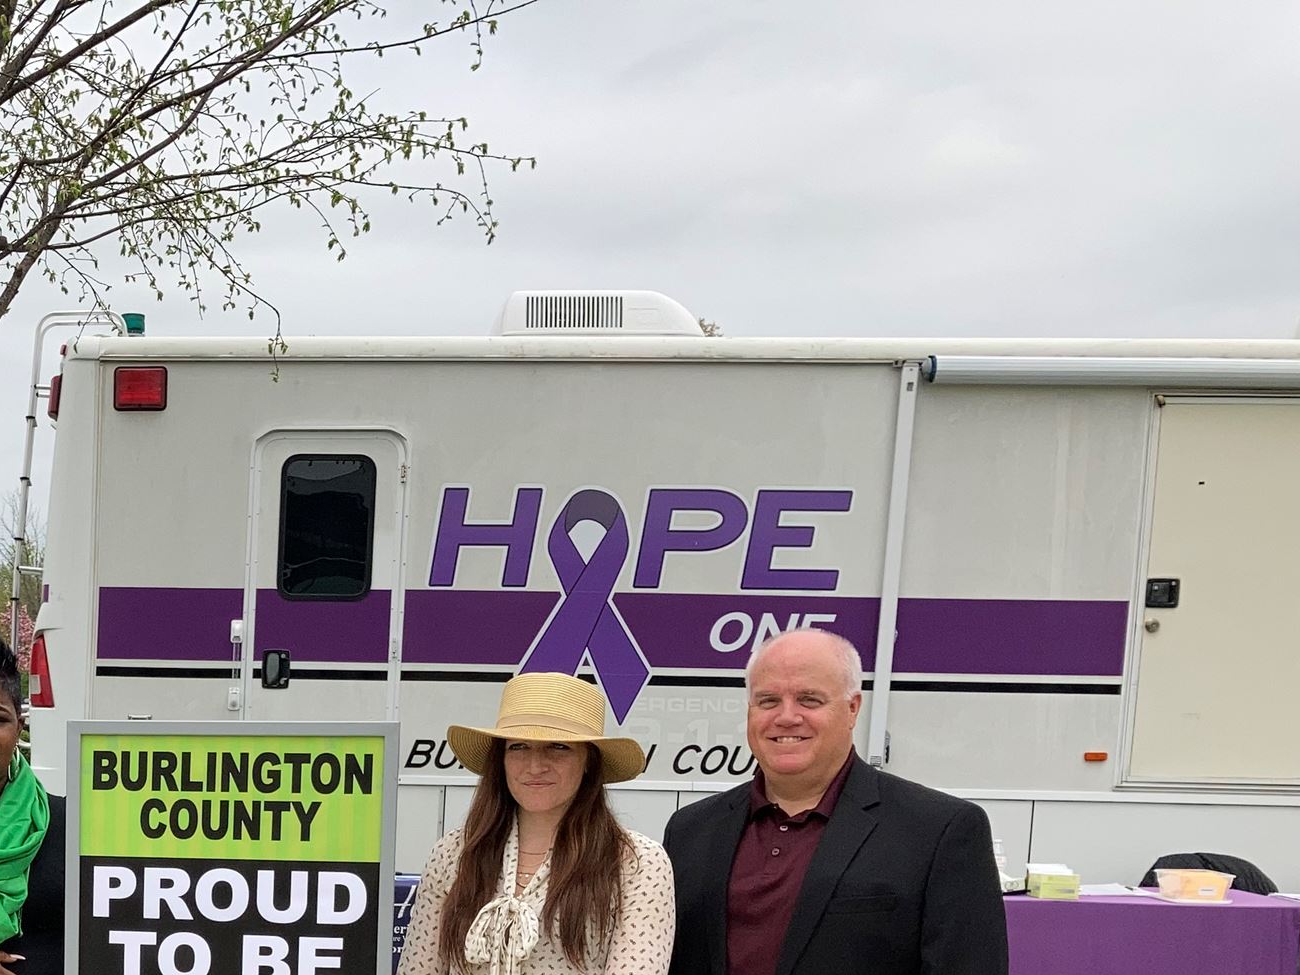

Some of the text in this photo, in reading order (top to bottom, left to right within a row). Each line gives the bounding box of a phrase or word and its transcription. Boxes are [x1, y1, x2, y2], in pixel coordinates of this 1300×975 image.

[634, 697, 749, 713] ERGENC
[92, 750, 374, 795] BURLINGTON
[673, 744, 756, 776] COU
[140, 798, 322, 842] COUNTY
[92, 865, 367, 925] PROUD
